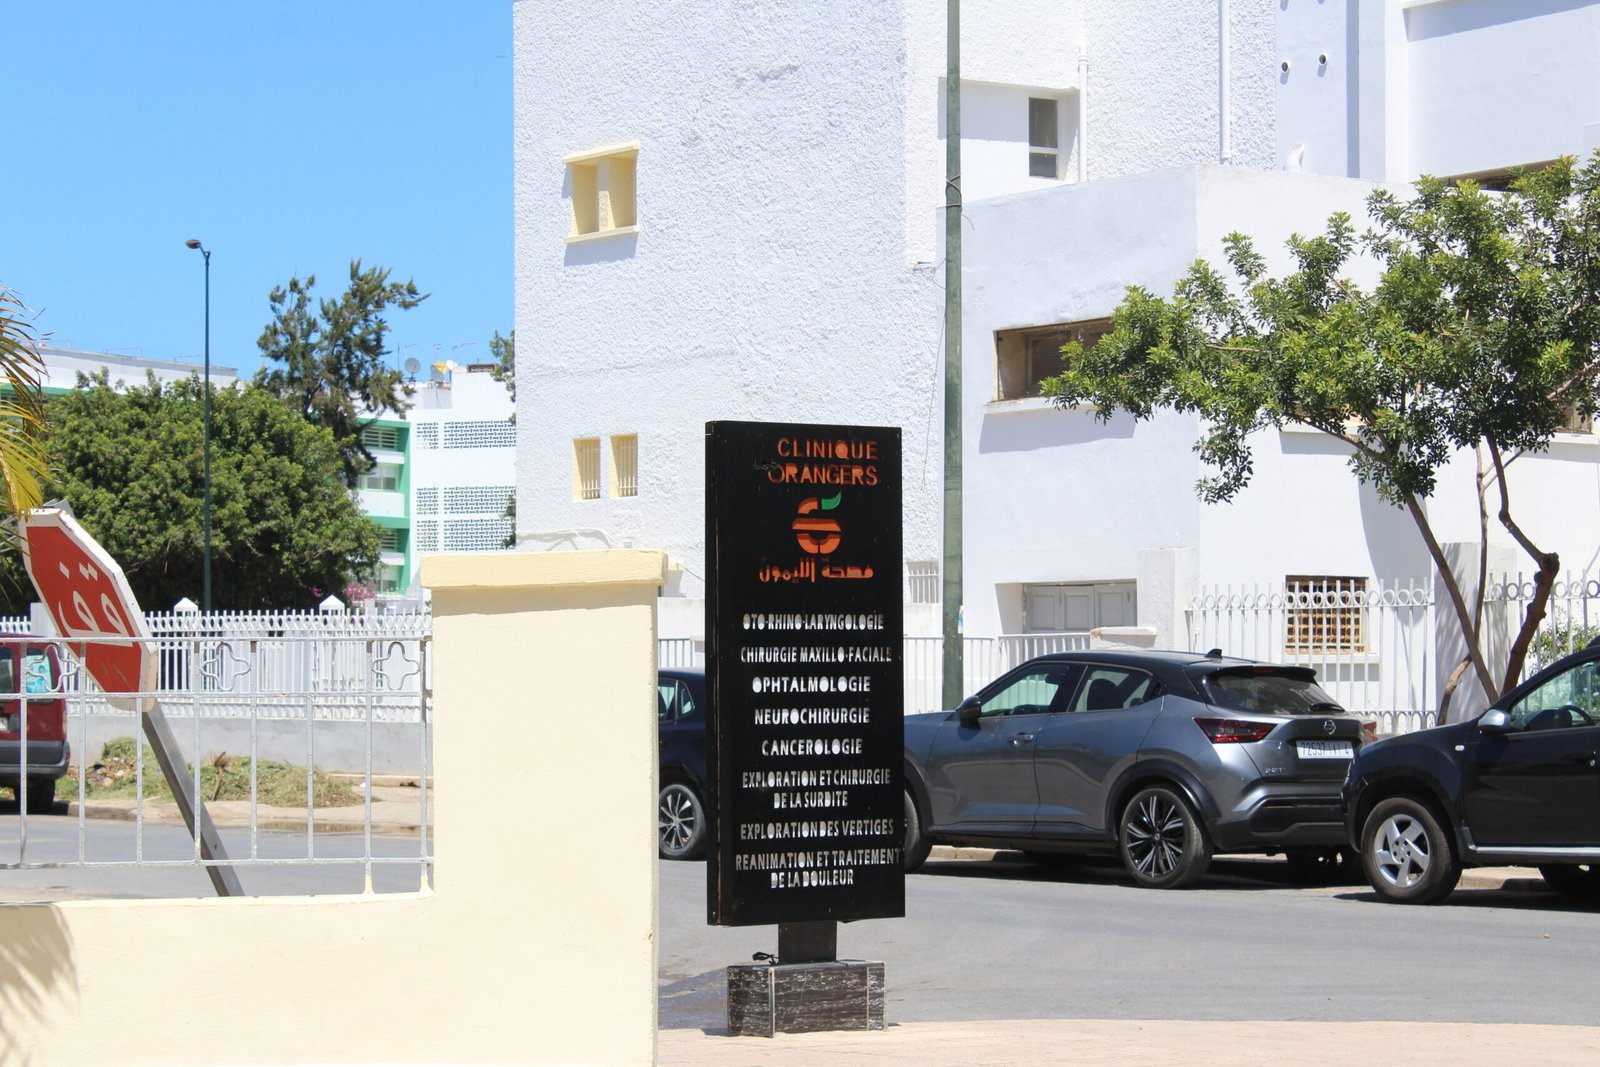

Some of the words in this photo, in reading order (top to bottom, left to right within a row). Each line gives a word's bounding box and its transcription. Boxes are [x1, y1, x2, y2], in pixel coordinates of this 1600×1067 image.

[777, 437, 878, 460] CLINIQUE
[768, 463, 879, 486] ORANGERS
[59, 562, 133, 647] قف
[743, 612, 884, 630] OTO-RHINO-LARYNGOLOGIE
[740, 646, 797, 663] CHIRURGIE
[800, 646, 892, 663] MAXILLO-FACIALE
[752, 676, 871, 693] OPHTALMOLOGIE
[754, 707, 870, 725] NEUROCHIRURGIE
[761, 738, 863, 756] CANCEROLOGIE
[742, 770, 817, 788] EXPLORATION
[819, 769, 832, 786] ET
[833, 768, 891, 786] CHIRURGIE
[773, 792, 787, 809] DE
[789, 792, 801, 808] LA
[804, 790, 849, 808] SURDITE
[740, 821, 818, 840] EXPLORATION
[819, 820, 839, 837] DES
[841, 818, 894, 836] VERTIGES
[735, 852, 814, 870] REANIMATION
[817, 851, 829, 867] ET
[832, 848, 901, 866] TRAITEMENT
[770, 872, 785, 888] DE
[787, 871, 801, 888] LA
[802, 869, 854, 887] DOULEUR
